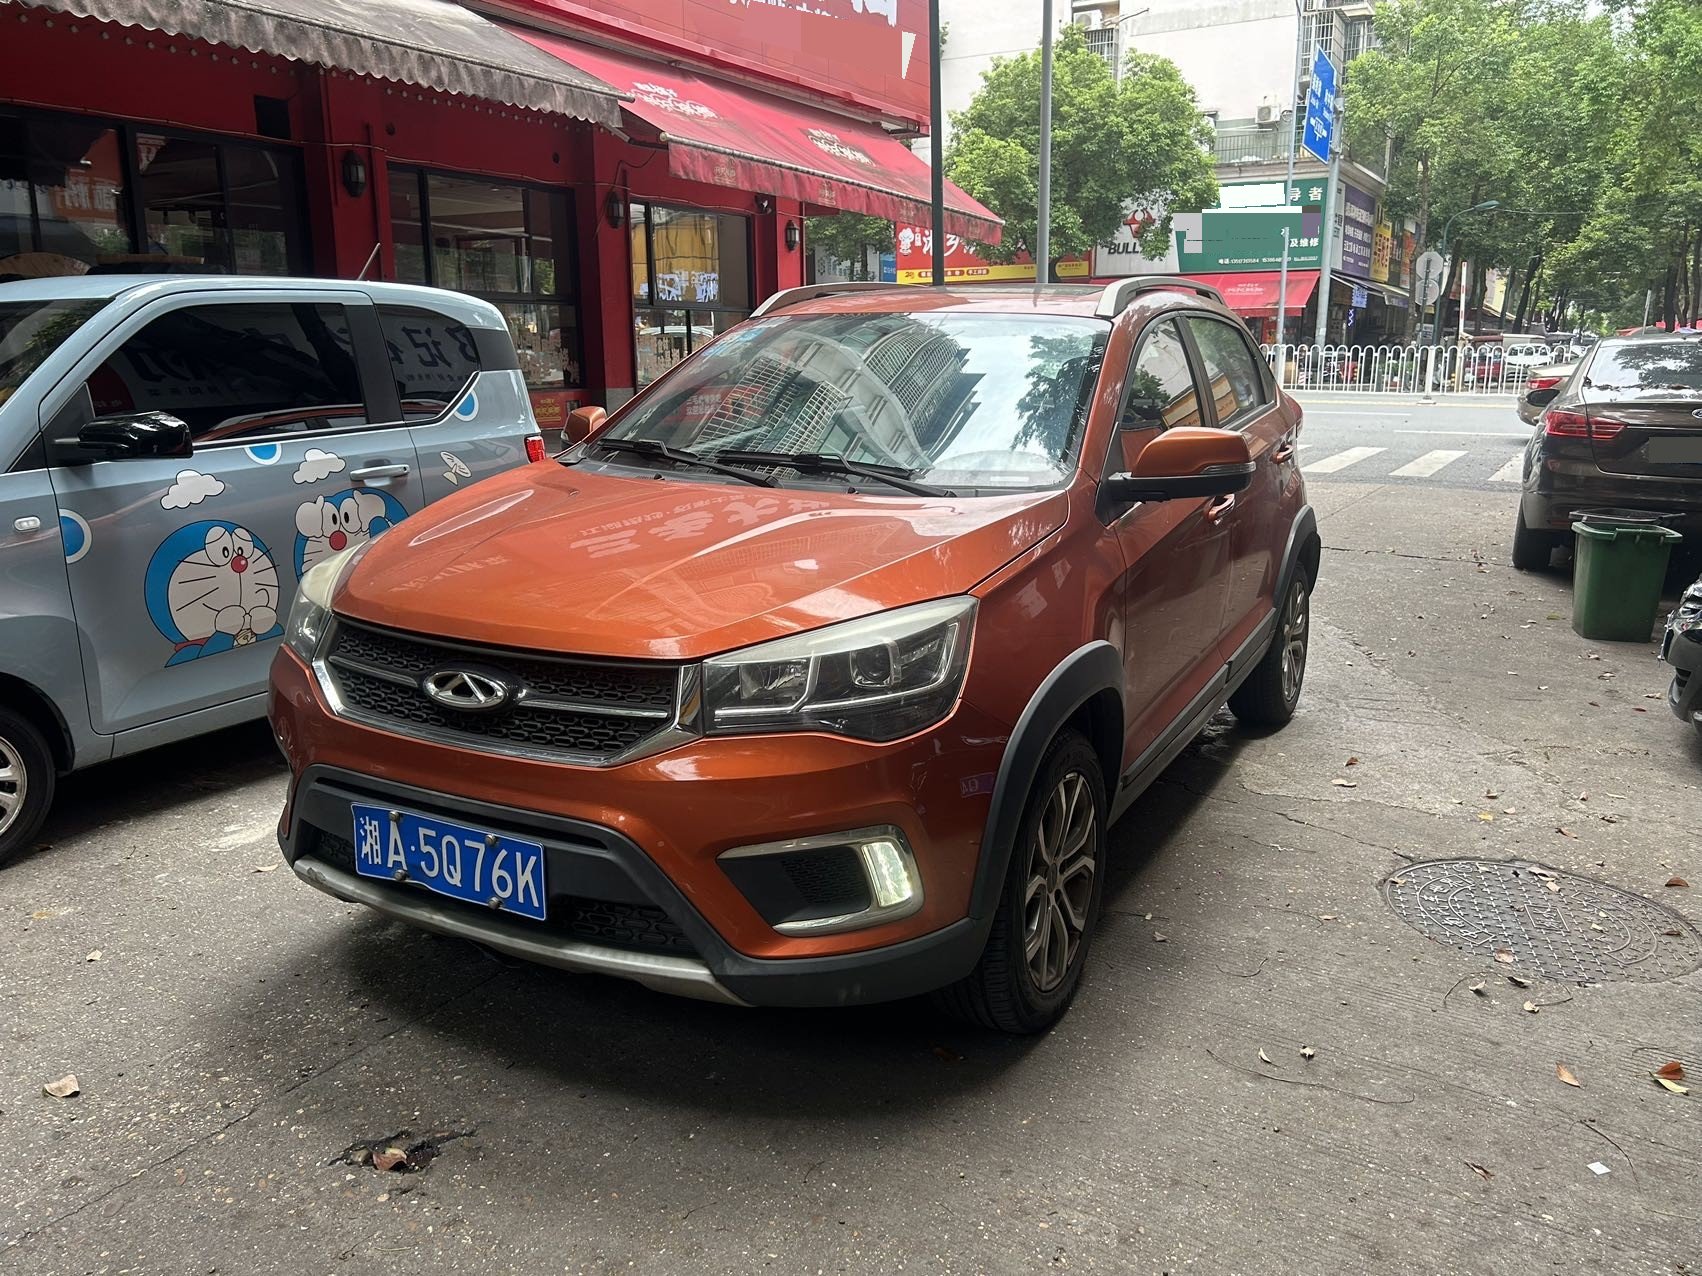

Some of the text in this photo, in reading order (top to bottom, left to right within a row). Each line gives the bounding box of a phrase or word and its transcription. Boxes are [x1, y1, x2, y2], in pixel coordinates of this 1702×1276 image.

[1107, 242, 1140, 255] BULL
[1289, 237, 1320, 248] 及维修
[360, 815, 540, 908] 湘A·5Q76K
